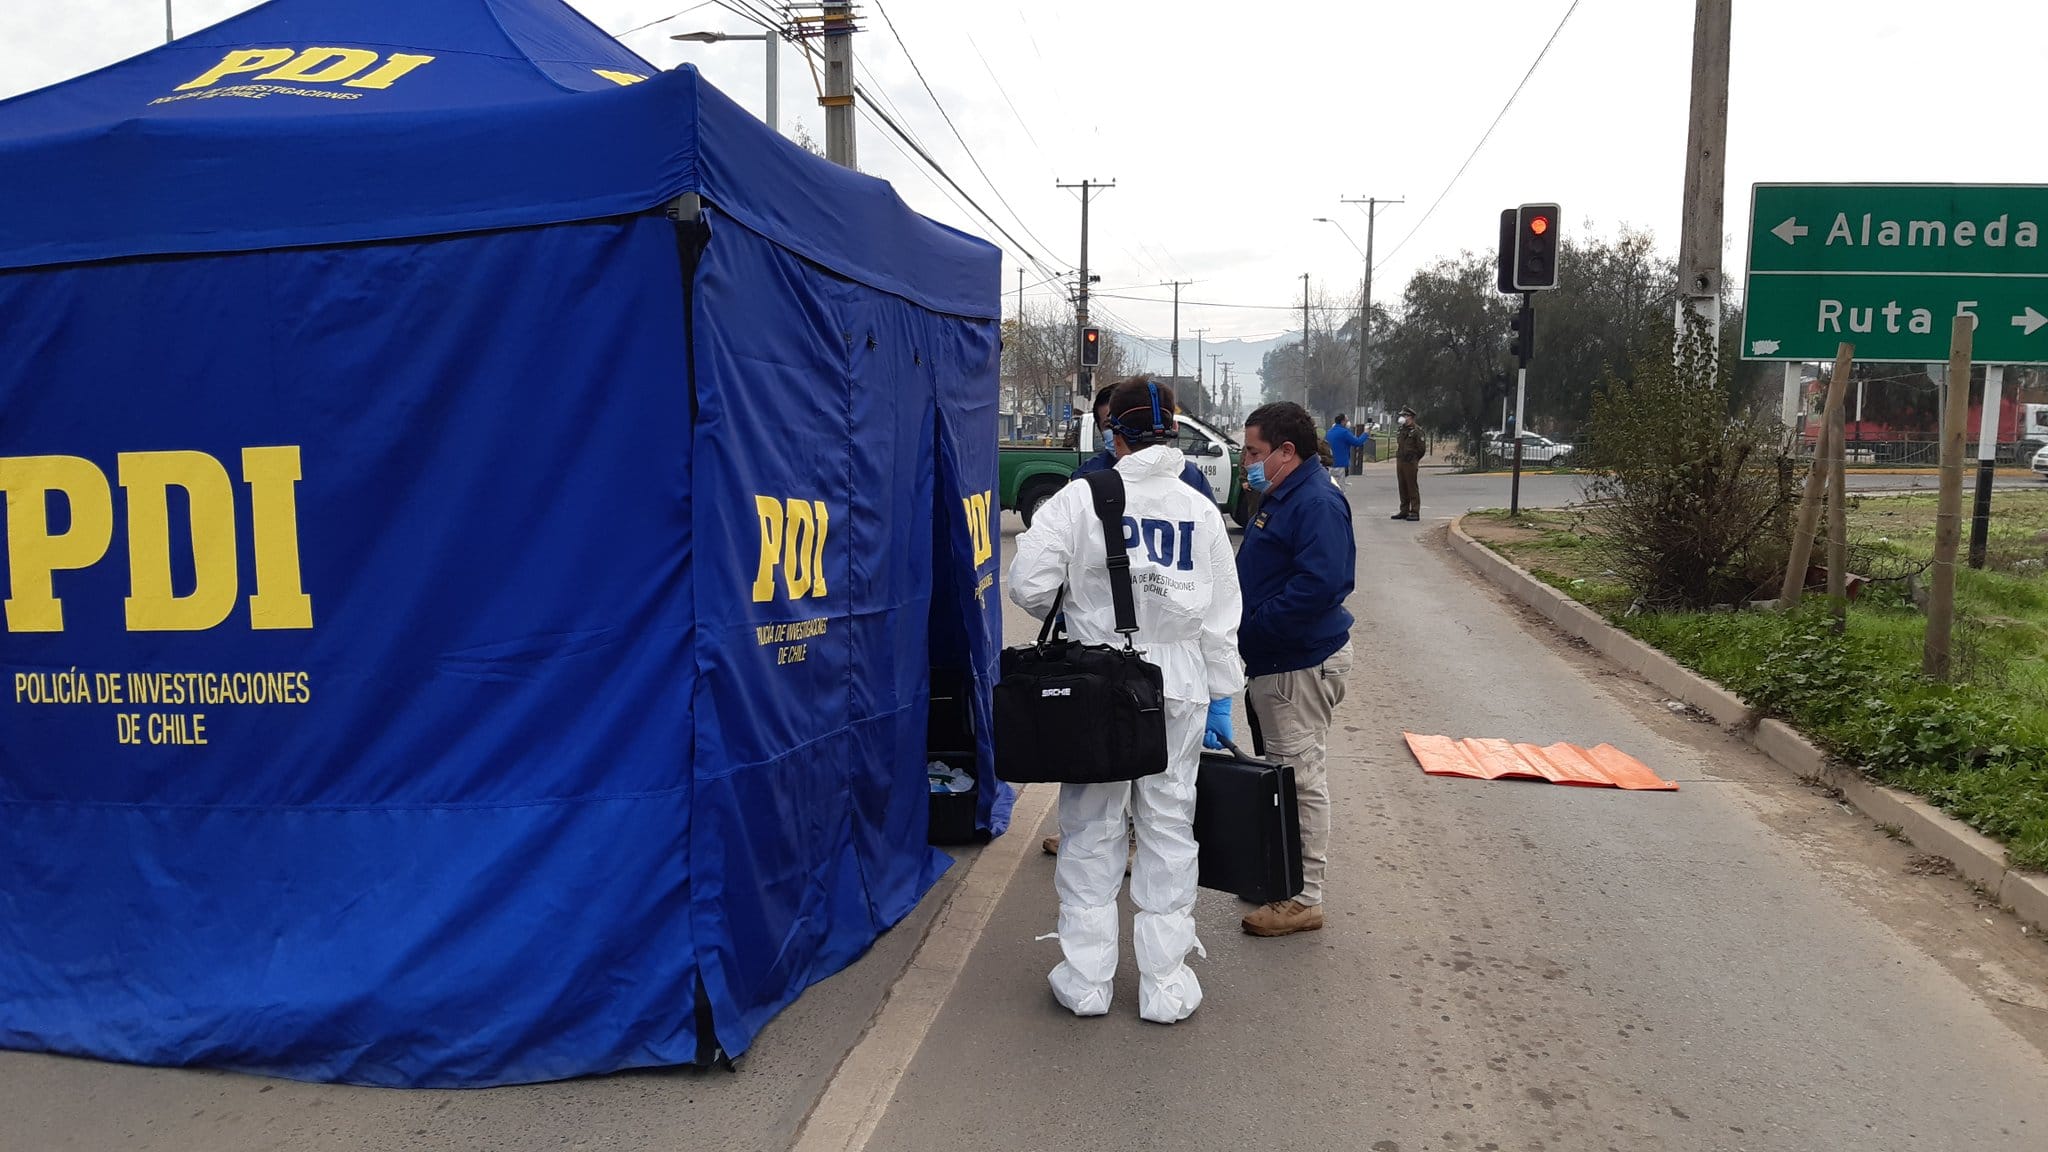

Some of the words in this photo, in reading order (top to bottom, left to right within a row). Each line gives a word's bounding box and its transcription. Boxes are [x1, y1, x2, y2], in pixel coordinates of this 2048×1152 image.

[173, 47, 436, 92] PDI
[1825, 211, 2038, 247] Alameda
[1817, 299, 1932, 334] Ruta
[1956, 300, 1979, 332] 5
[0, 445, 313, 632] PDI
[752, 495, 829, 602] PDI
[1139, 574, 1147, 584] DE
[1149, 573, 1196, 591] INVESTIACIONES
[1150, 584, 1168, 597] CHILE
[775, 624, 787, 642] DE
[778, 647, 789, 665] DE
[788, 643, 807, 663] CHILE
[15, 666, 91, 703] POLICÍA
[95, 673, 123, 703] DE
[127, 672, 311, 704] INVESTIGACIONES
[117, 713, 141, 744] DE
[148, 713, 208, 744] CHILE
